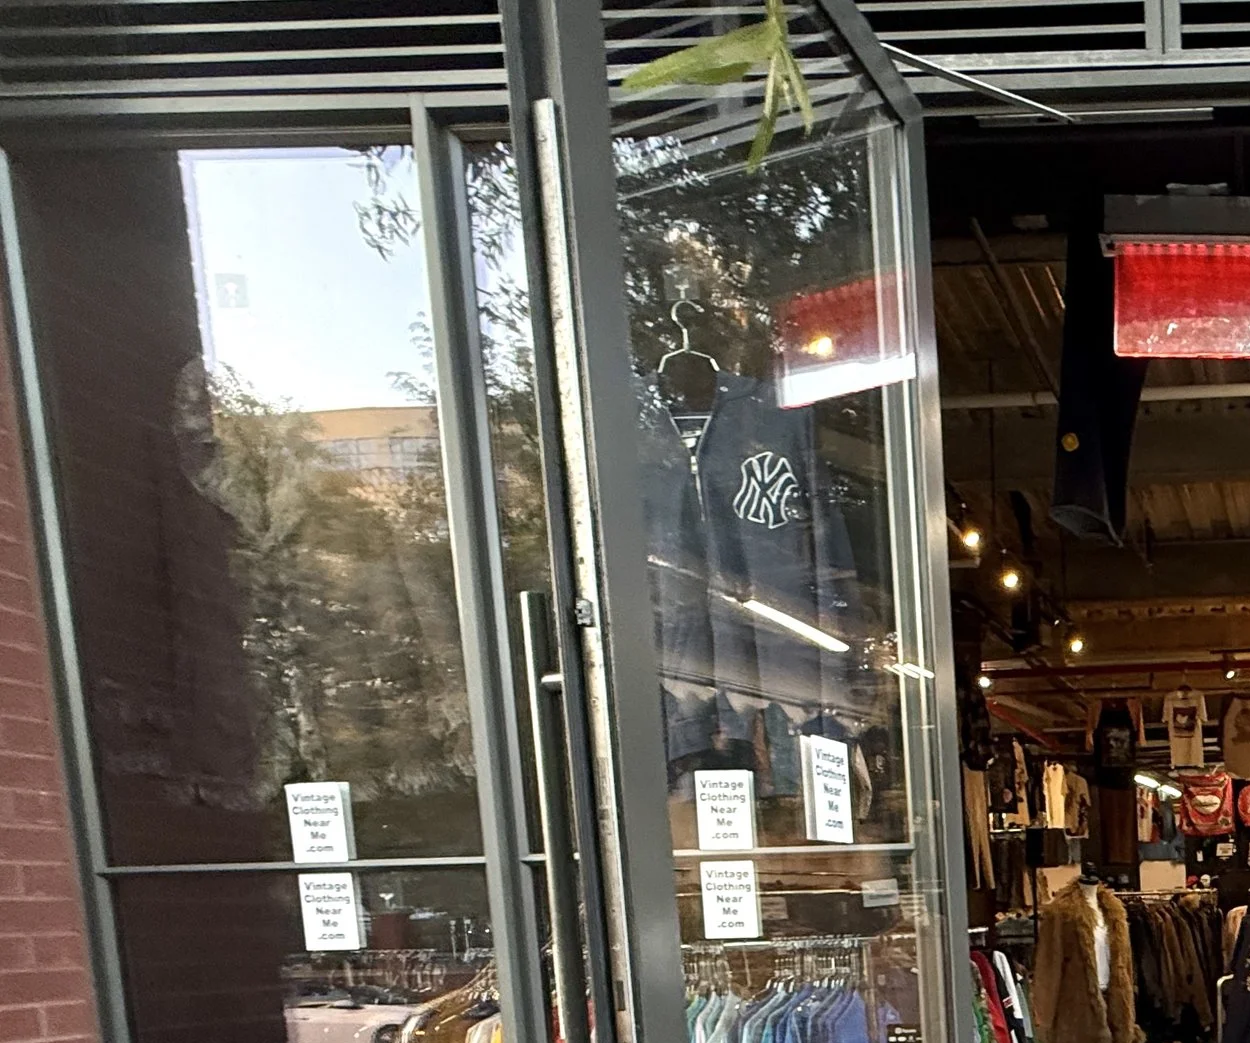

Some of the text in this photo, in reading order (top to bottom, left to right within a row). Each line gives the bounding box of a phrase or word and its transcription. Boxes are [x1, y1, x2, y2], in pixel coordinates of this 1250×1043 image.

[814, 748, 844, 767] Vintage
[815, 765, 846, 784] Clothing
[700, 779, 744, 790] Vintage
[823, 782, 841, 797] Near
[292, 793, 336, 804] Vintage
[699, 793, 746, 803] Clothing
[292, 806, 339, 816] Clothing
[710, 805, 737, 814] Near
[828, 800, 839, 812] Me
[716, 818, 733, 826] Me
[706, 870, 749, 879] Vintage
[304, 882, 347, 892] Vintage
[705, 882, 751, 892] Clothing
[304, 894, 350, 904] Clothing
[716, 895, 742, 903] Near
[316, 907, 342, 915] Near
[722, 907, 738, 915] Me
